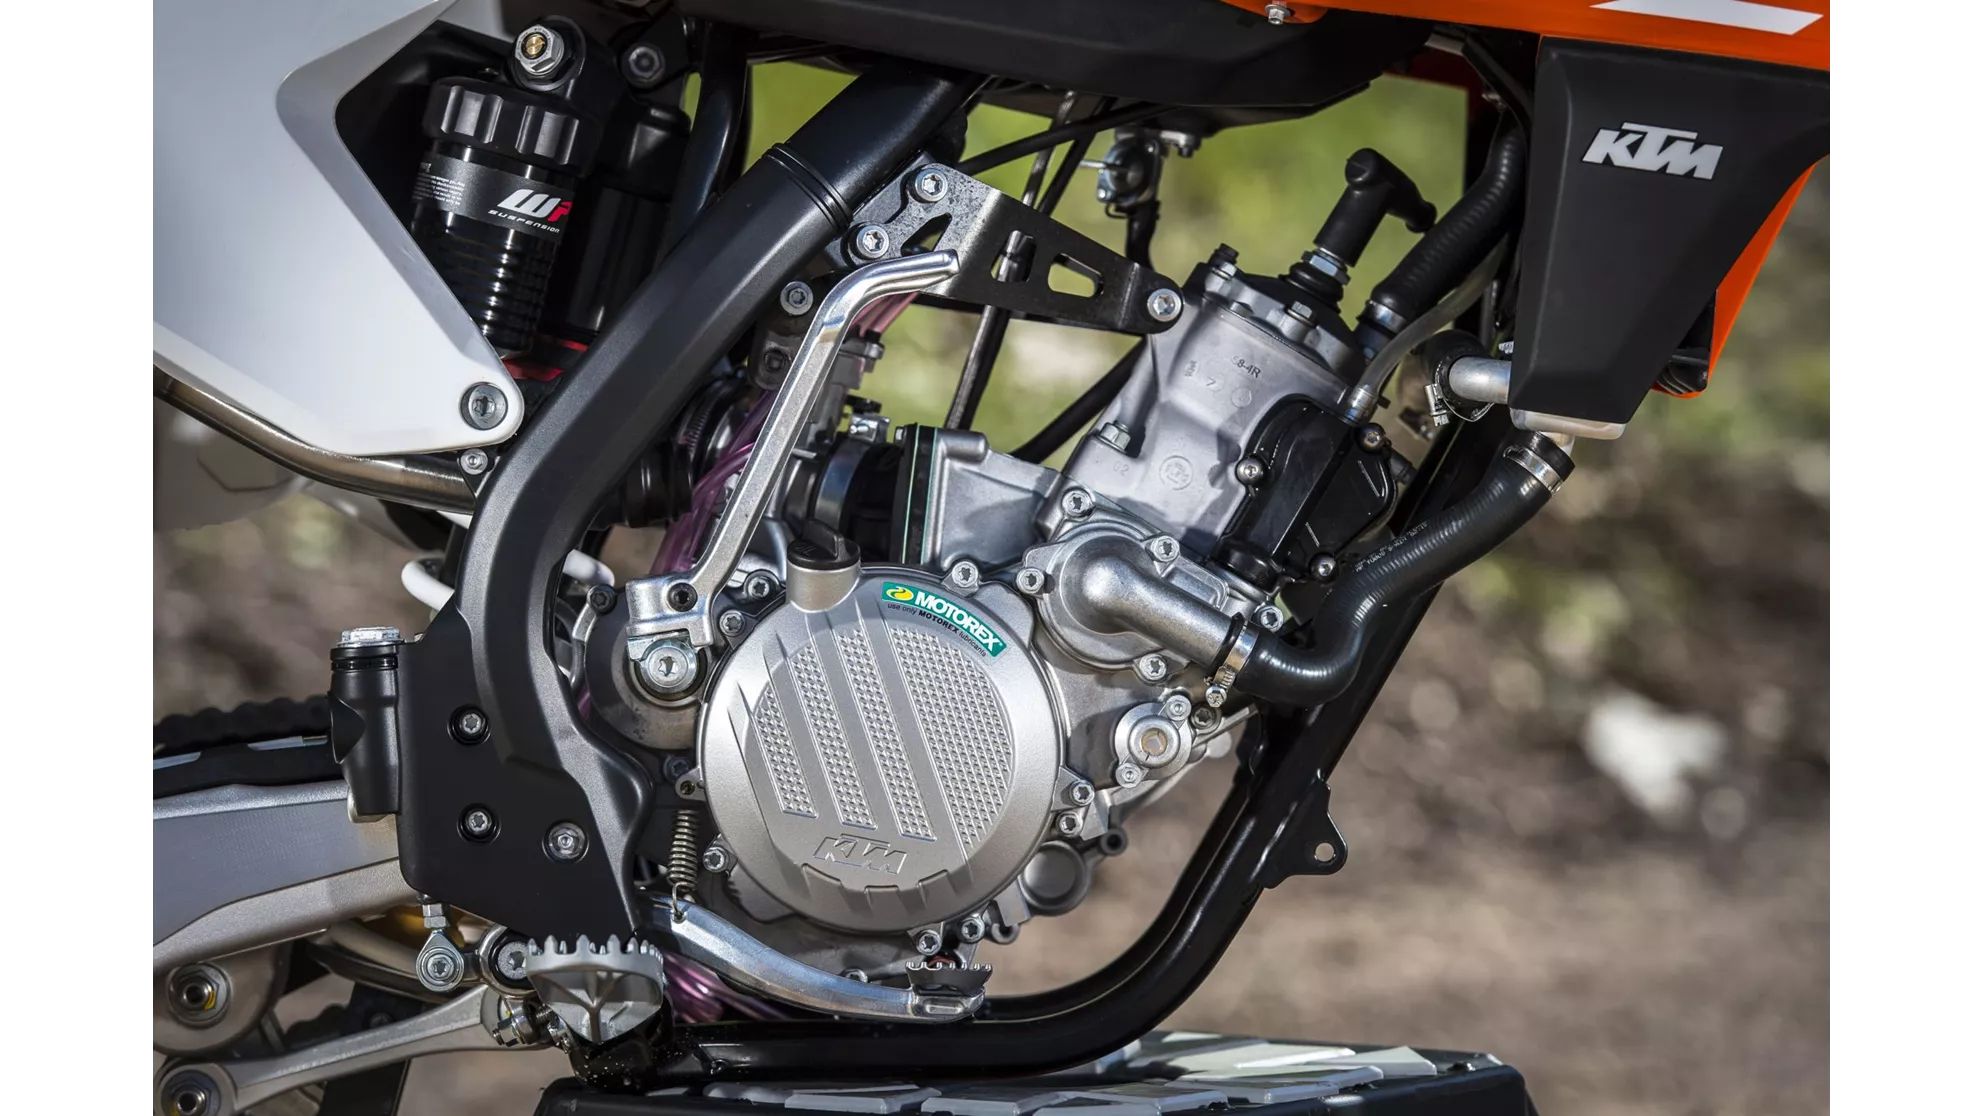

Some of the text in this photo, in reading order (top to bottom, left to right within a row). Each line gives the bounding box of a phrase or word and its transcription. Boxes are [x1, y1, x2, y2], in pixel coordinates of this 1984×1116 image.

[1582, 122, 1723, 180] KTM
[487, 208, 561, 233] SUSPENSION
[887, 603, 901, 611] use
[902, 604, 918, 616] only
[918, 609, 960, 635] MOTOREX
[914, 590, 1001, 652] MOTOREX
[812, 832, 908, 875] KTM
